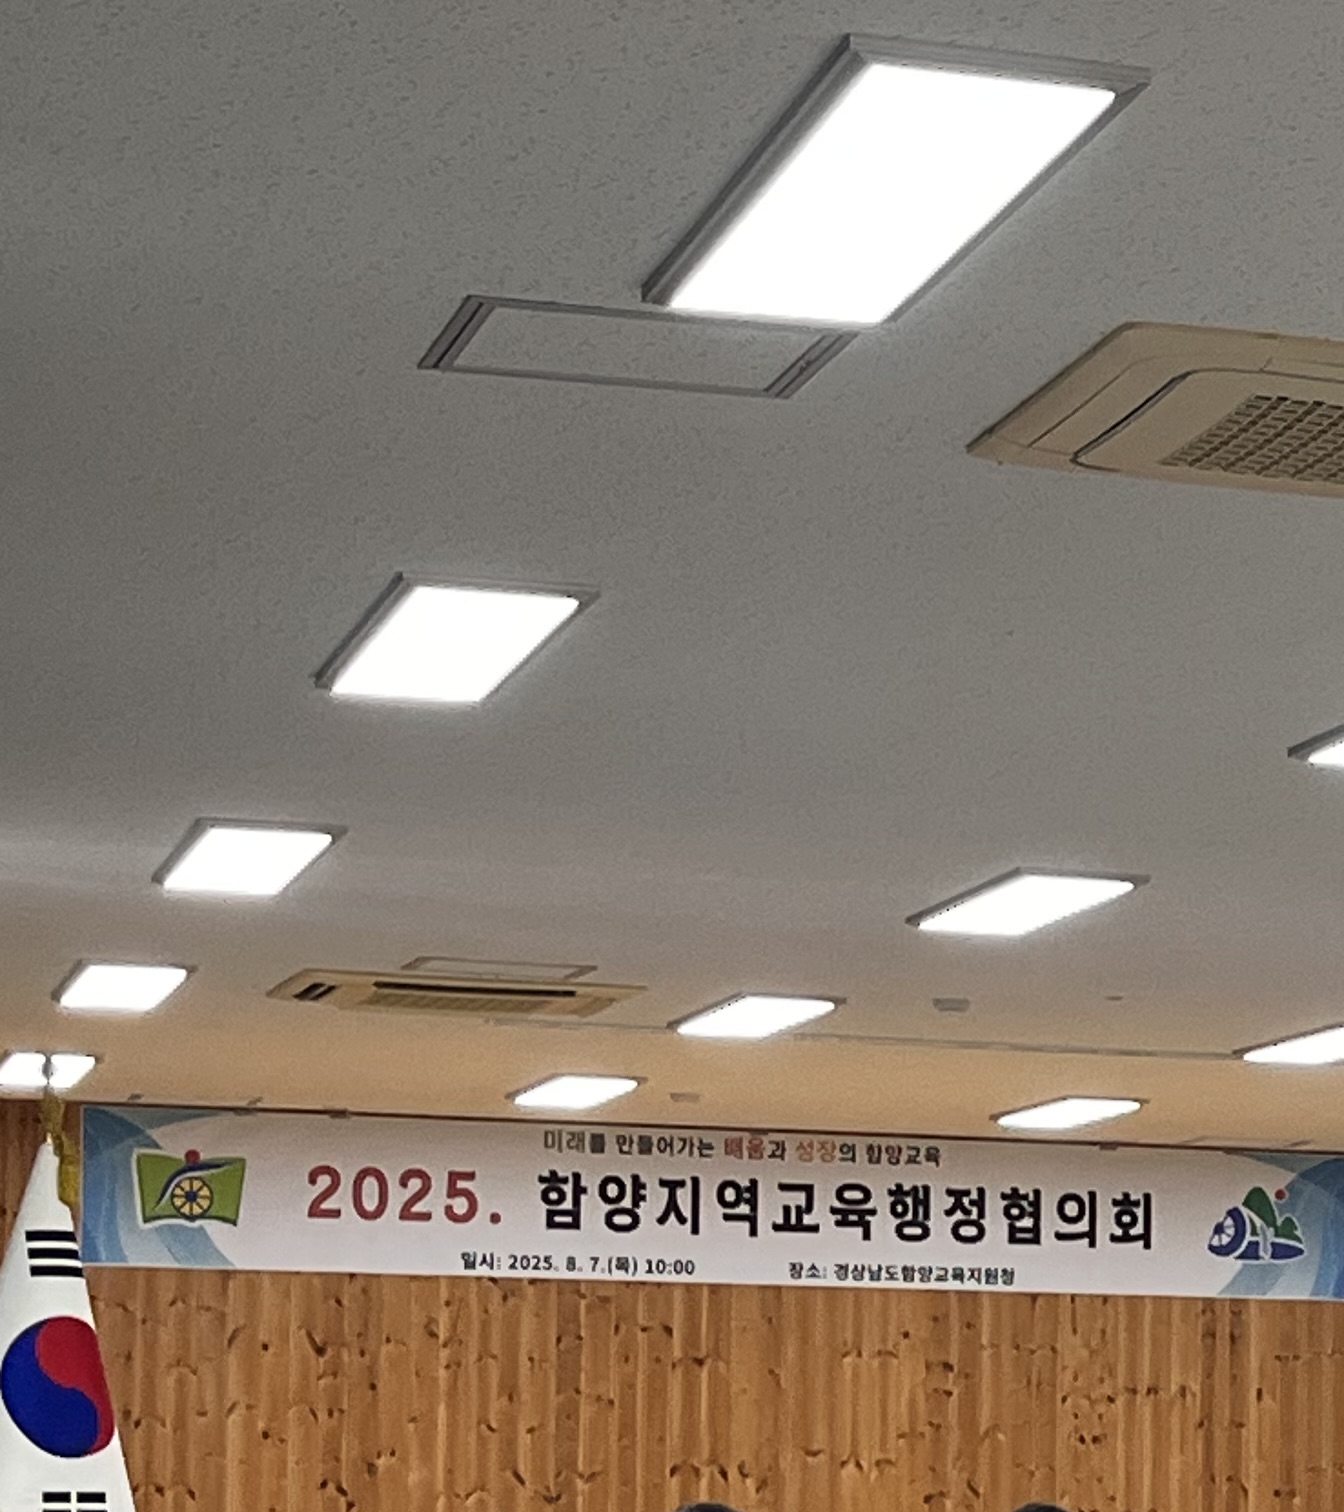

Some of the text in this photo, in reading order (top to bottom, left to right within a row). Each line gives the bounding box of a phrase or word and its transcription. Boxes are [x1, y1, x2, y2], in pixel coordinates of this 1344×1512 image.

[543, 1129, 942, 1168] 미래를 만들어가는 배움과 성장의 함양교육
[306, 1164, 1154, 1250] 2025. 함양지역교육행정협의회
[460, 1251, 502, 1272] 일시:
[508, 1254, 560, 1273] 2025.
[644, 1258, 696, 1276] 10:00
[788, 1261, 828, 1280] 장소:
